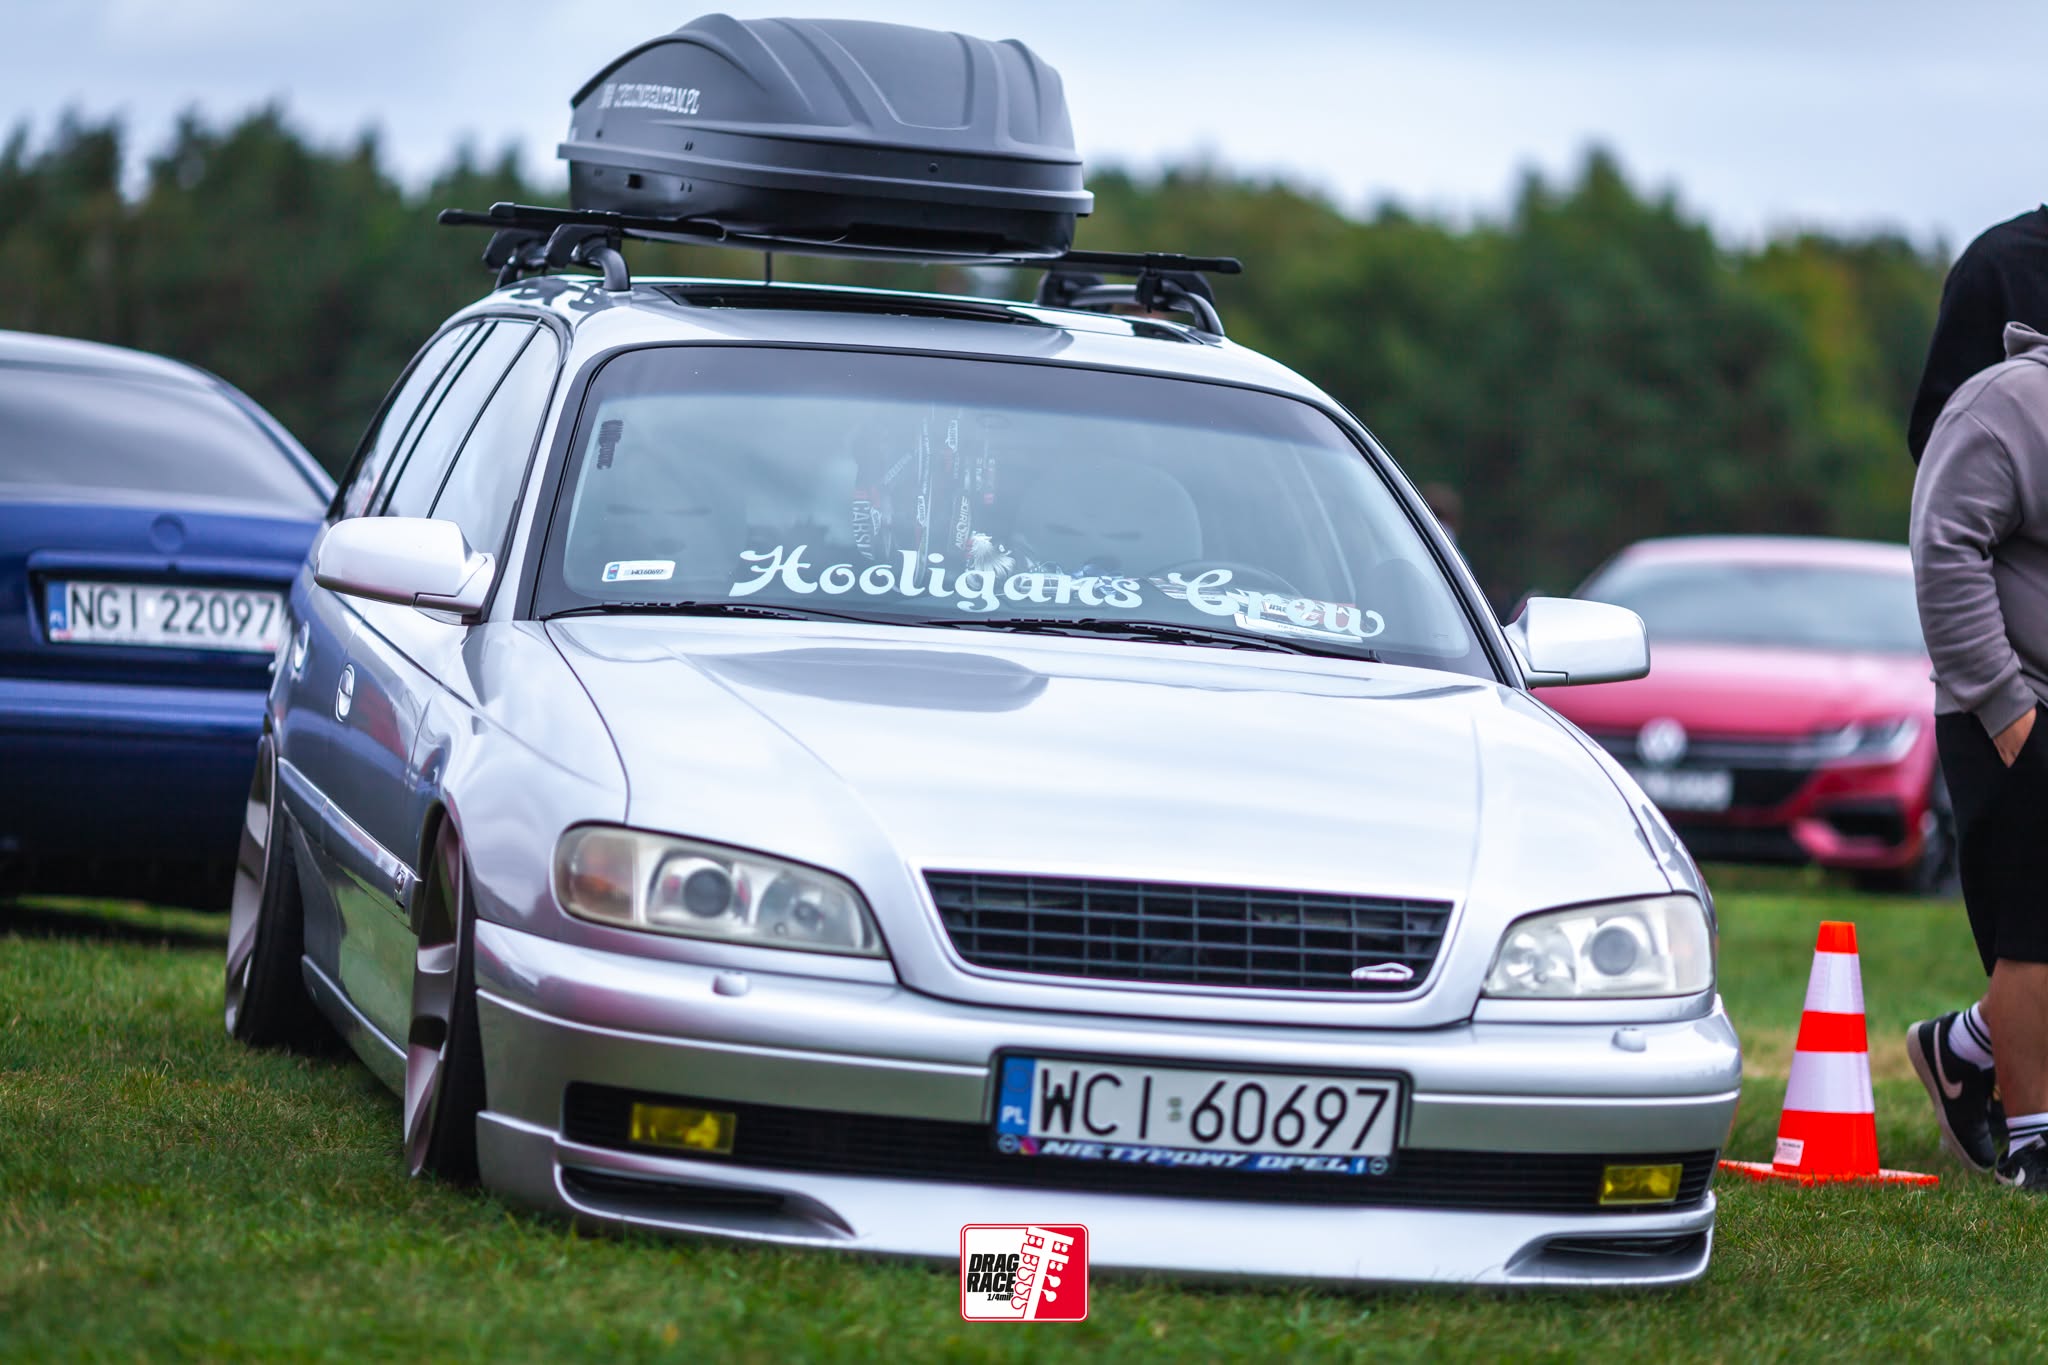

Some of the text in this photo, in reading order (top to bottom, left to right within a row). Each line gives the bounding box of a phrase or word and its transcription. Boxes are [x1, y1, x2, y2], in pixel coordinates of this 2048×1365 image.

[71, 587, 276, 635] NGI 22097
[728, 544, 1385, 637] Hooligans Crew
[1001, 1106, 1027, 1126] PL
[1040, 1069, 1391, 1151] WCI 60697
[1255, 1156, 1349, 1173] OPEL
